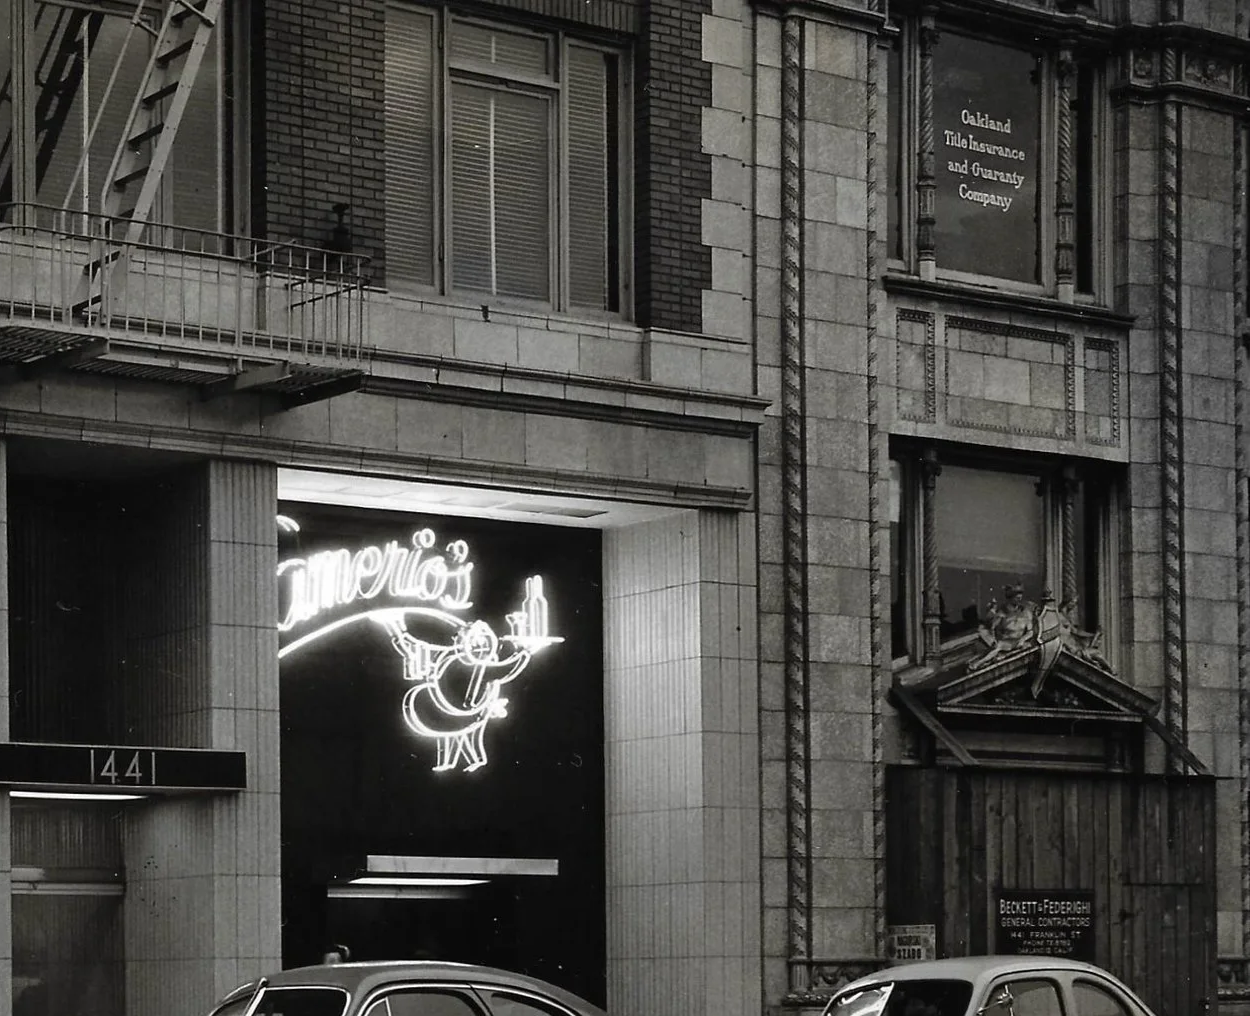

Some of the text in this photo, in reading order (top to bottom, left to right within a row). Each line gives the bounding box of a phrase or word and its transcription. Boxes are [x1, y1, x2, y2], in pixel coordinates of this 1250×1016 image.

[961, 109, 1011, 134] Oakland
[944, 130, 1025, 160] Title Insurance
[948, 160, 1025, 189] and Guaranty
[959, 183, 1012, 212] Company
[277, 514, 474, 658] amerio's
[91, 749, 156, 785] 1441
[1001, 917, 1090, 927] GENERAL CONTRACTORS
